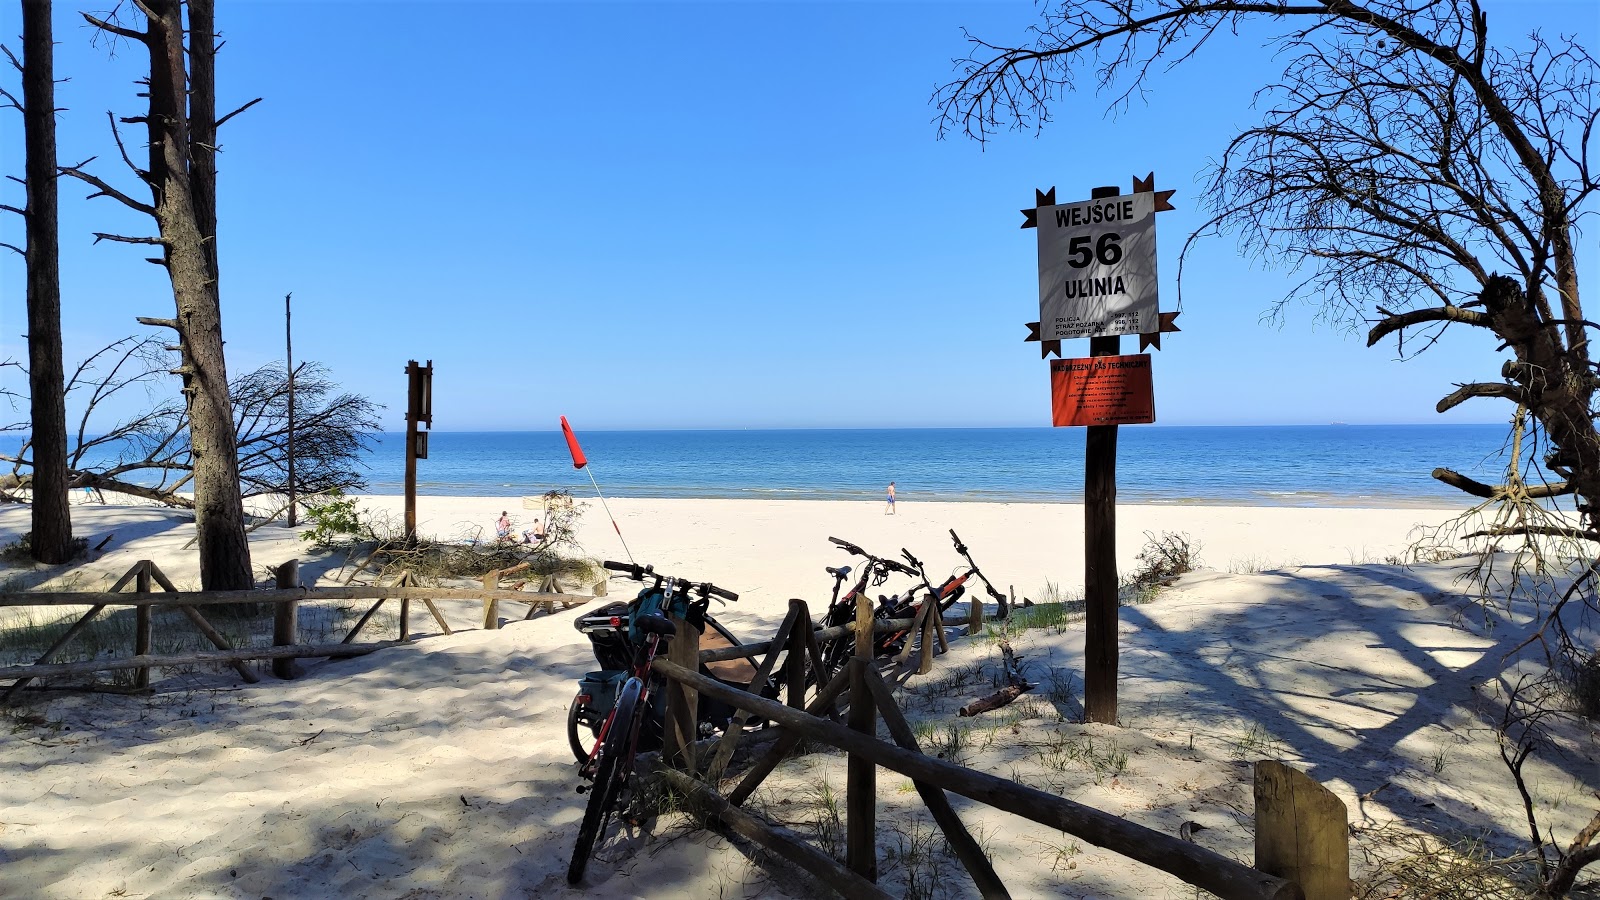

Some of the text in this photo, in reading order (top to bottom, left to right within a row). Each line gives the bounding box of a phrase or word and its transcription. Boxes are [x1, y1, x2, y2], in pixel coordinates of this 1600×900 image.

[1055, 200, 1134, 228] WEJŚCIE
[1067, 232, 1123, 268] 56
[1065, 276, 1126, 299] ULINIA
